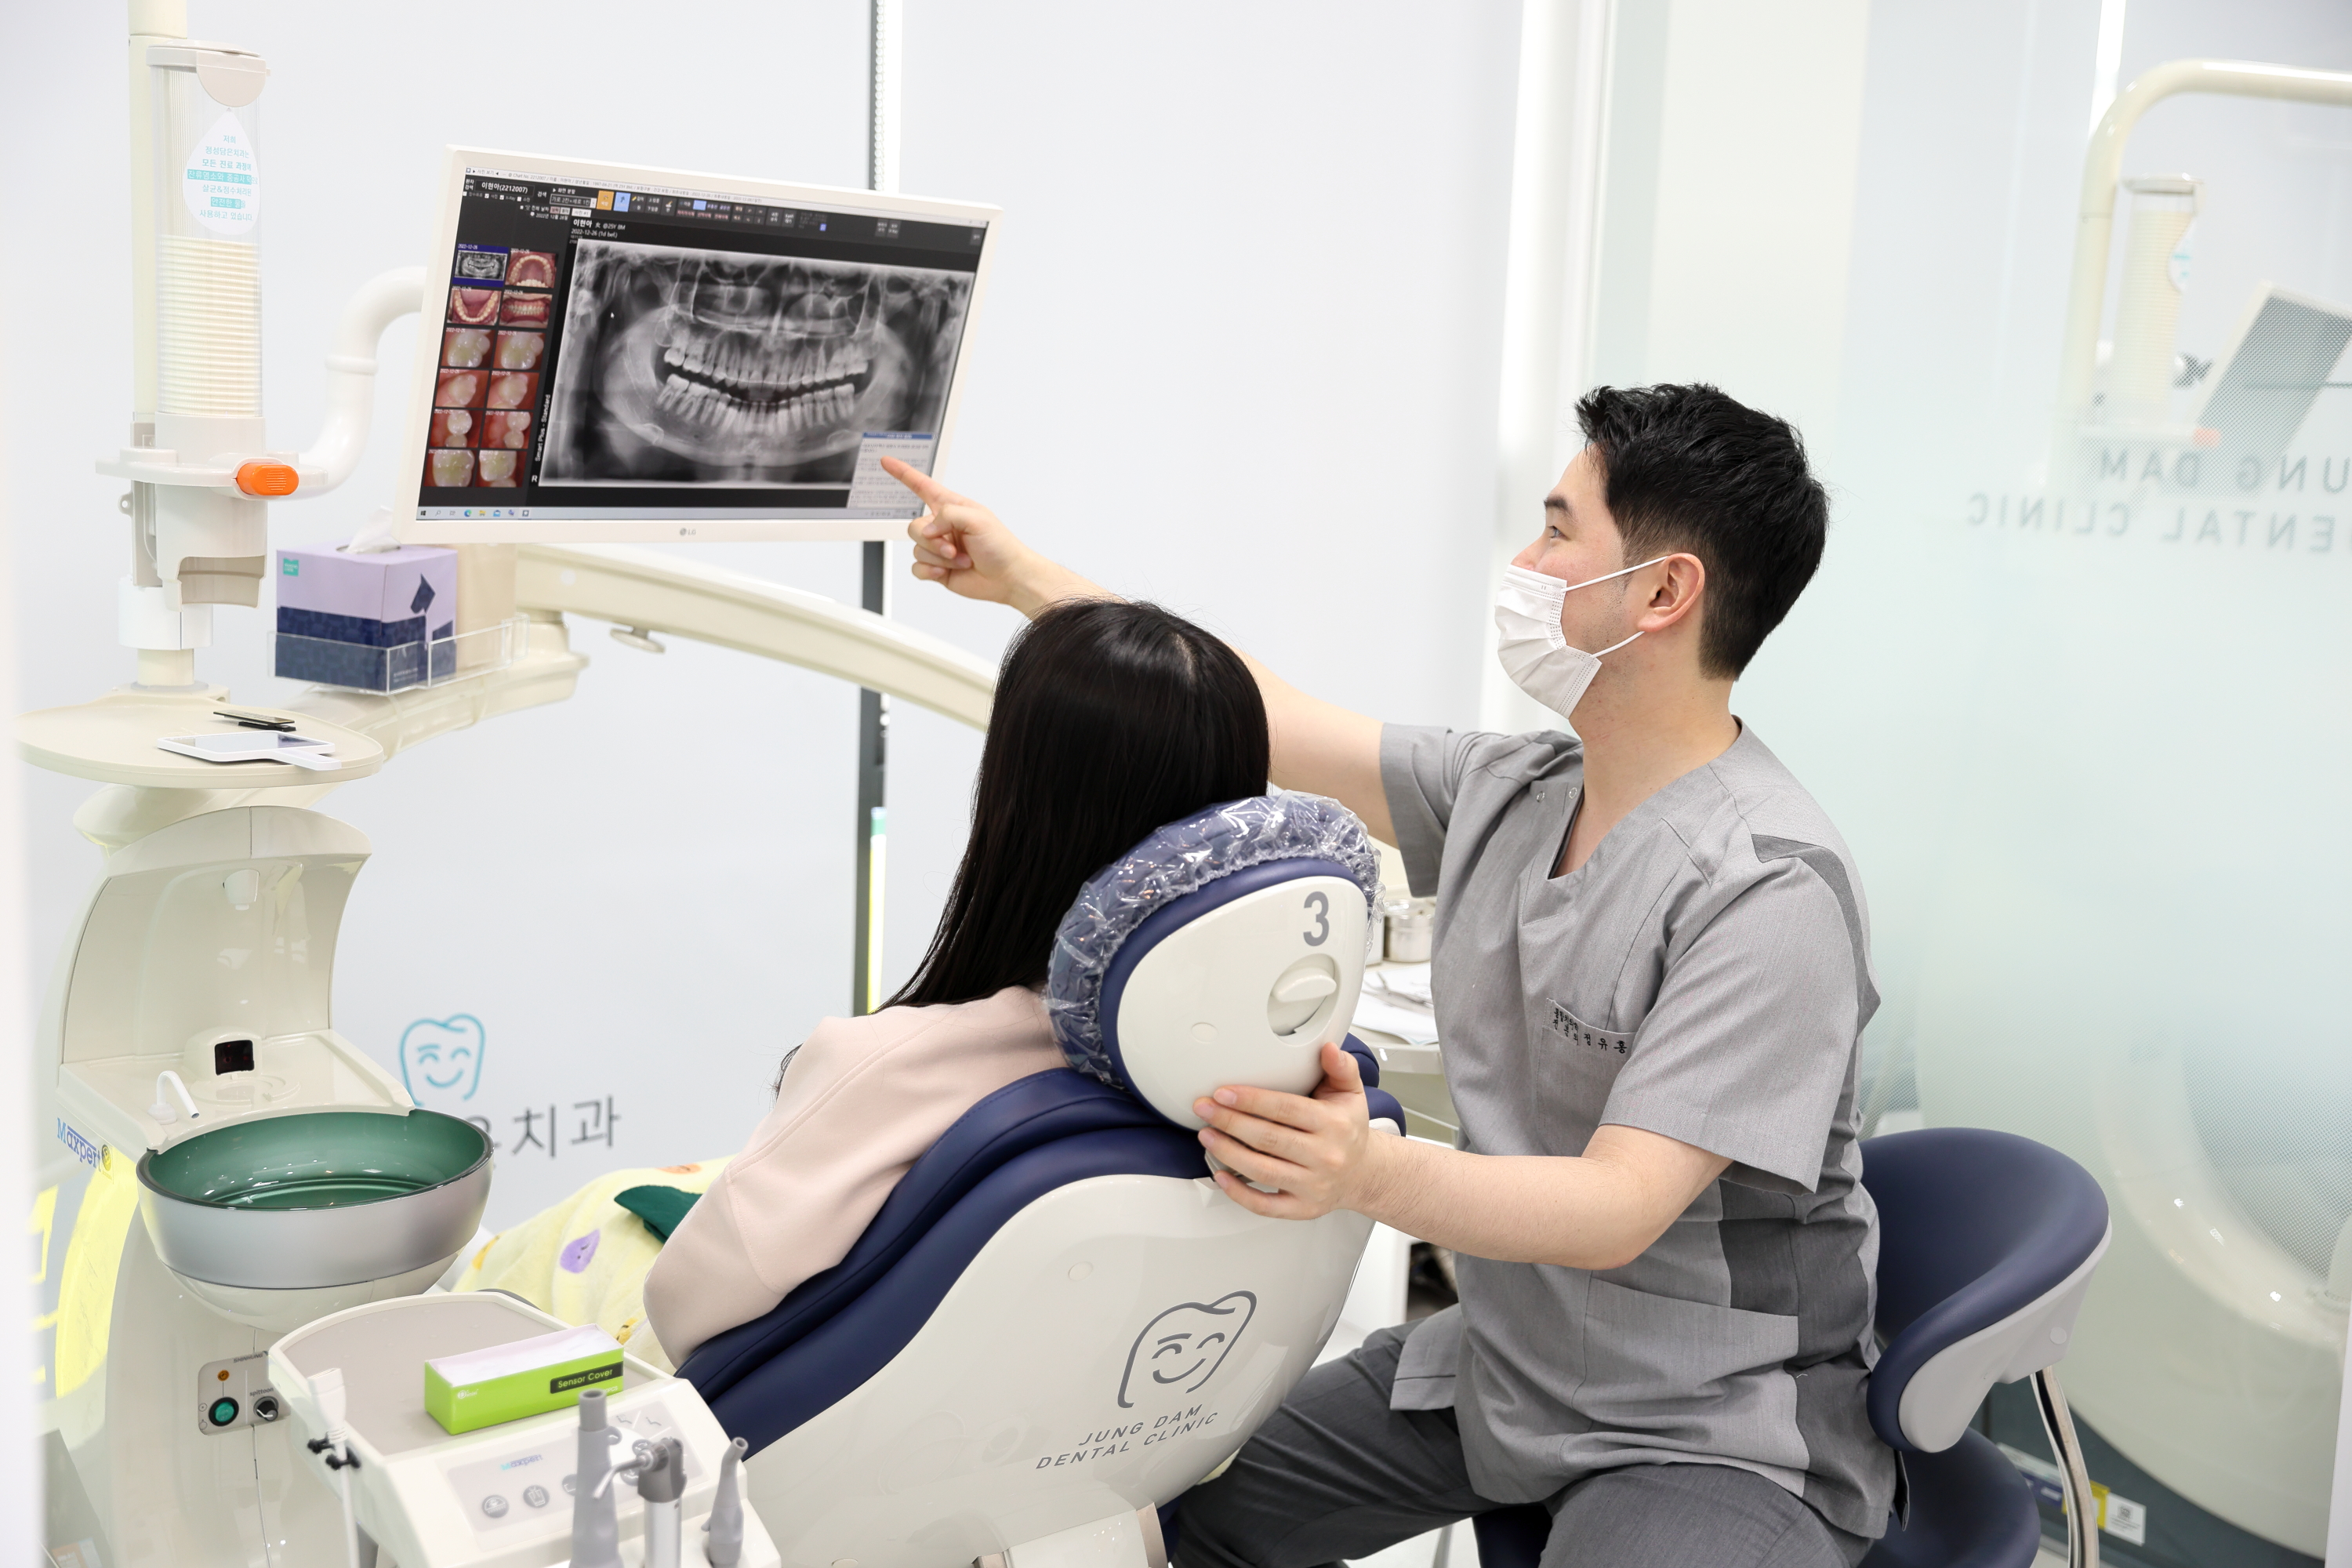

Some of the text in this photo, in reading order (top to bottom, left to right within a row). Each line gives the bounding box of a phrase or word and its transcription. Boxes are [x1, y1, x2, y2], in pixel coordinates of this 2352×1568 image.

[223, 135, 236, 143] 저희
[205, 146, 249, 158] 정성담은치과는
[202, 158, 252, 171] 모든 진료 과정에
[188, 170, 224, 181] 잔류염소와
[227, 173, 245, 183] 중공사
[202, 184, 252, 196] 살균&정수처리된
[481, 181, 528, 194] 이현아(2212007)
[212, 198, 245, 209] 안전한 물을
[199, 209, 227, 219] 사용하고
[573, 218, 593, 228] 이현아
[571, 227, 597, 237] 2022-12-26
[535, 443, 543, 462] Smart
[541, 394, 550, 423] Standard
[1303, 891, 1330, 946] 3
[1584, 1033, 1628, 1054] 정유홍
[57, 1116, 101, 1172] Maxpert
[558, 1369, 613, 1388] Sensor Cover
[249, 1387, 274, 1397] spittoon
[1078, 1403, 1203, 1446] JUNG DAM
[1035, 1412, 1218, 1470] DENTAL CLINIC
